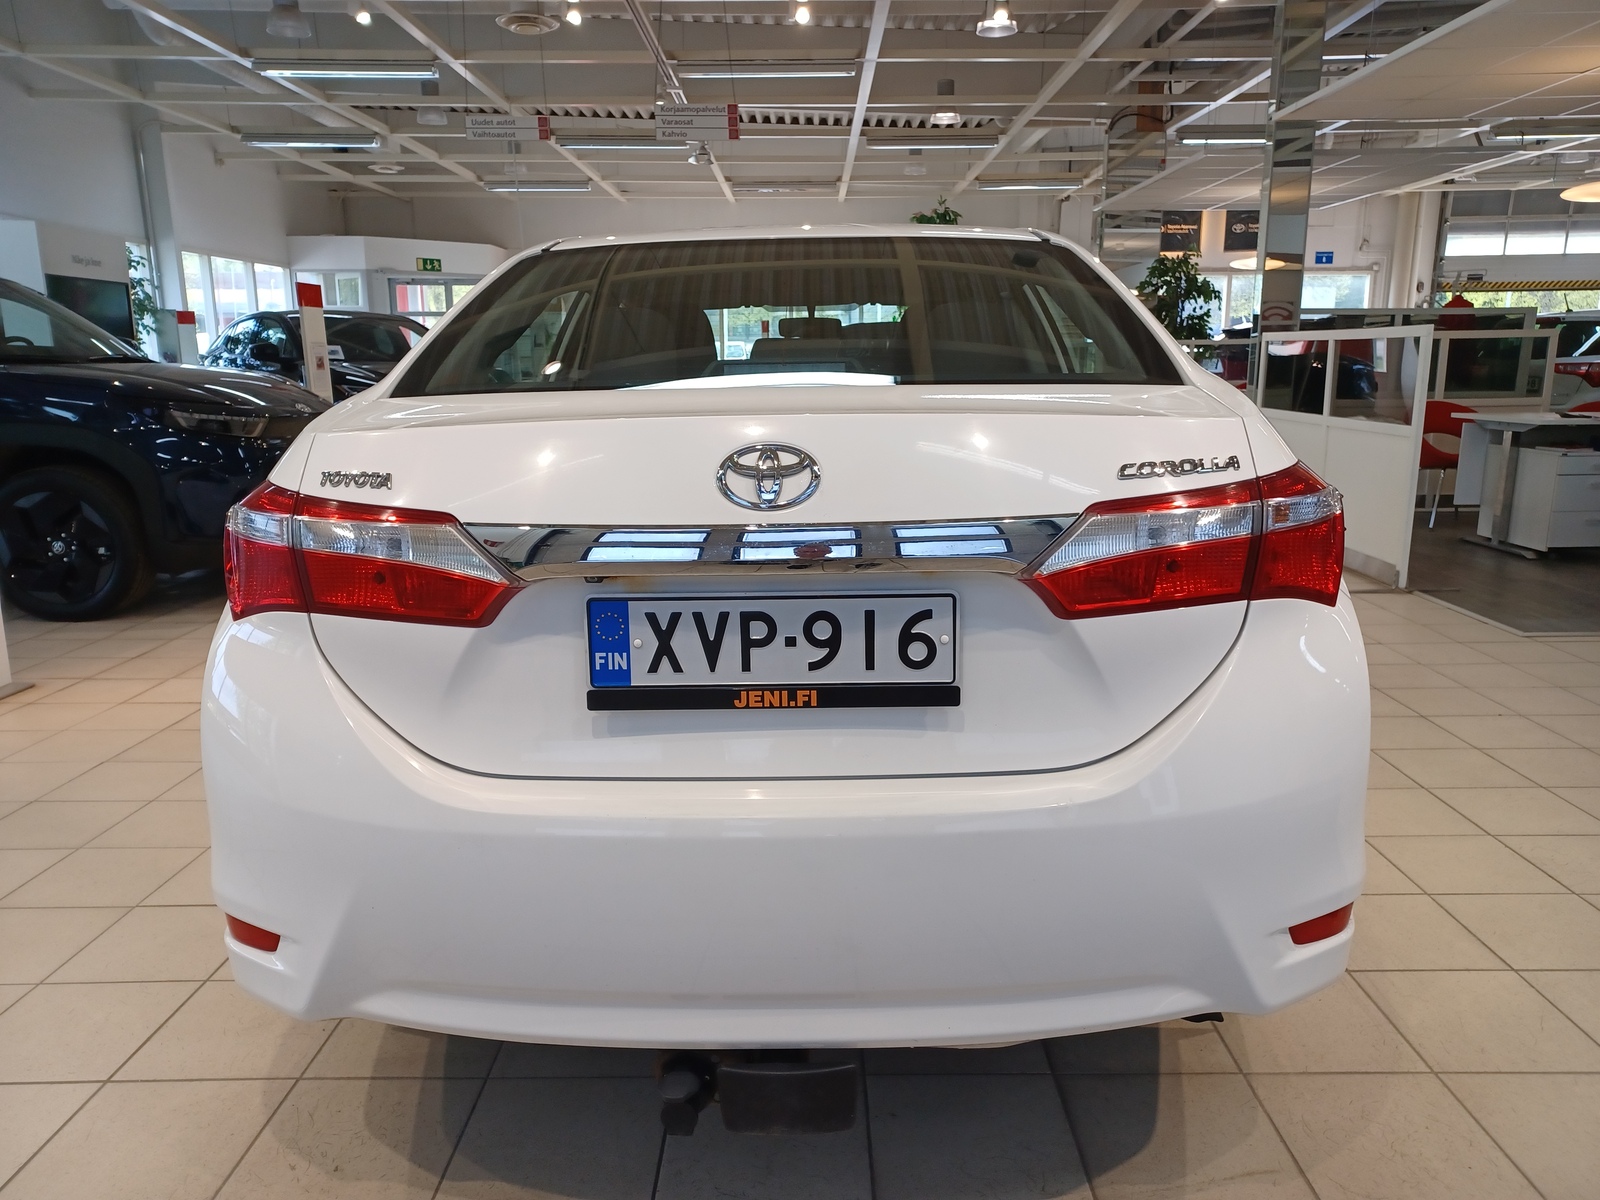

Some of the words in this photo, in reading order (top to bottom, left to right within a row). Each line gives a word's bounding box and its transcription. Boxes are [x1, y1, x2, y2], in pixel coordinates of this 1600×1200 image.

[660, 105, 727, 114] Korjaamopalvelut
[1117, 455, 1241, 480] COROLLA
[320, 470, 392, 490] TOYOTA
[594, 652, 628, 671] FIN
[644, 608, 938, 675] XVP-916
[734, 690, 818, 708] JENI.FI
